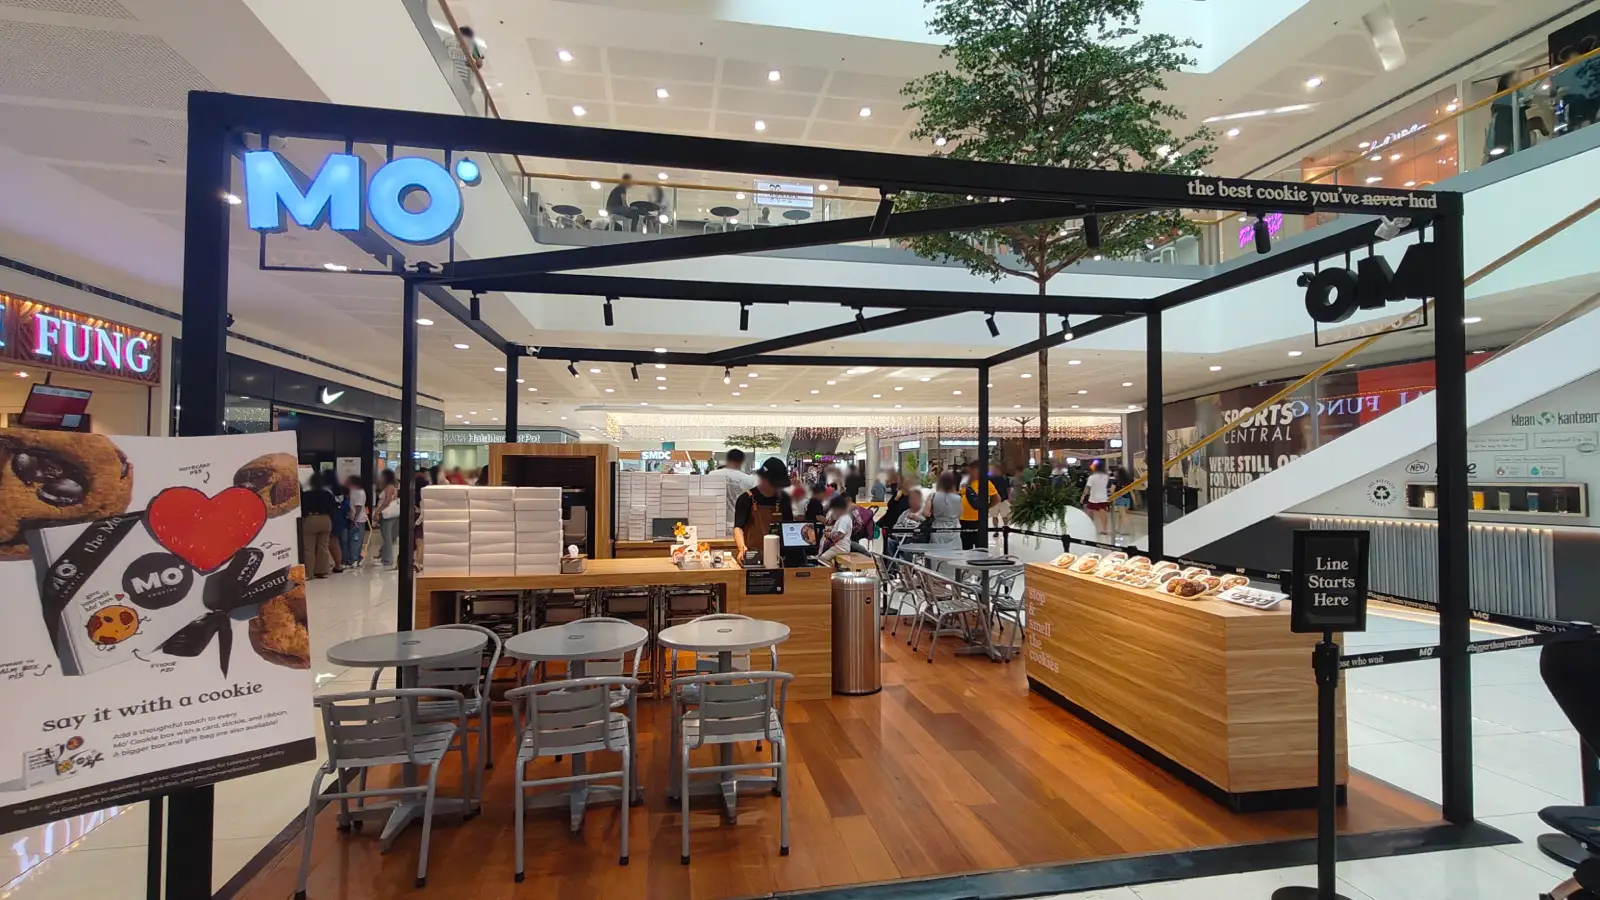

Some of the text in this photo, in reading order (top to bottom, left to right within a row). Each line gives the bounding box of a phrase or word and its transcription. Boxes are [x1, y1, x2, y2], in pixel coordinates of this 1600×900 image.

[1187, 179, 1438, 209] the best cookie you've never had
[33, 312, 151, 373] FUNG
[1224, 402, 1293, 428] SPORTS
[1511, 411, 1597, 427] klean kanteen
[1223, 426, 1292, 444] CENTRAL
[641, 451, 671, 460] SMDC
[1209, 456, 1235, 472] WE'RE
[1237, 455, 1272, 472] STILL
[1410, 464, 1426, 472] NEW
[1210, 473, 1225, 487] FOR
[1226, 473, 1253, 487] YOUR
[84, 534, 107, 553] the
[1316, 557, 1349, 571] Line
[1308, 575, 1355, 589] Starts
[1029, 588, 1046, 606] stop
[1313, 592, 1349, 607] Here
[1029, 602, 1036, 616] &
[1029, 619, 1051, 637] smell
[1535, 624, 1556, 633] good
[1029, 633, 1042, 649] the
[1029, 650, 1060, 673] cookies
[1352, 657, 1367, 666] who
[1368, 655, 1384, 664] wait
[42, 681, 263, 732] say it with a cookie
[139, 721, 182, 734] thoughtful
[184, 717, 206, 725] touch
[130, 735, 158, 744] Cookie
[122, 747, 148, 755] bigger
